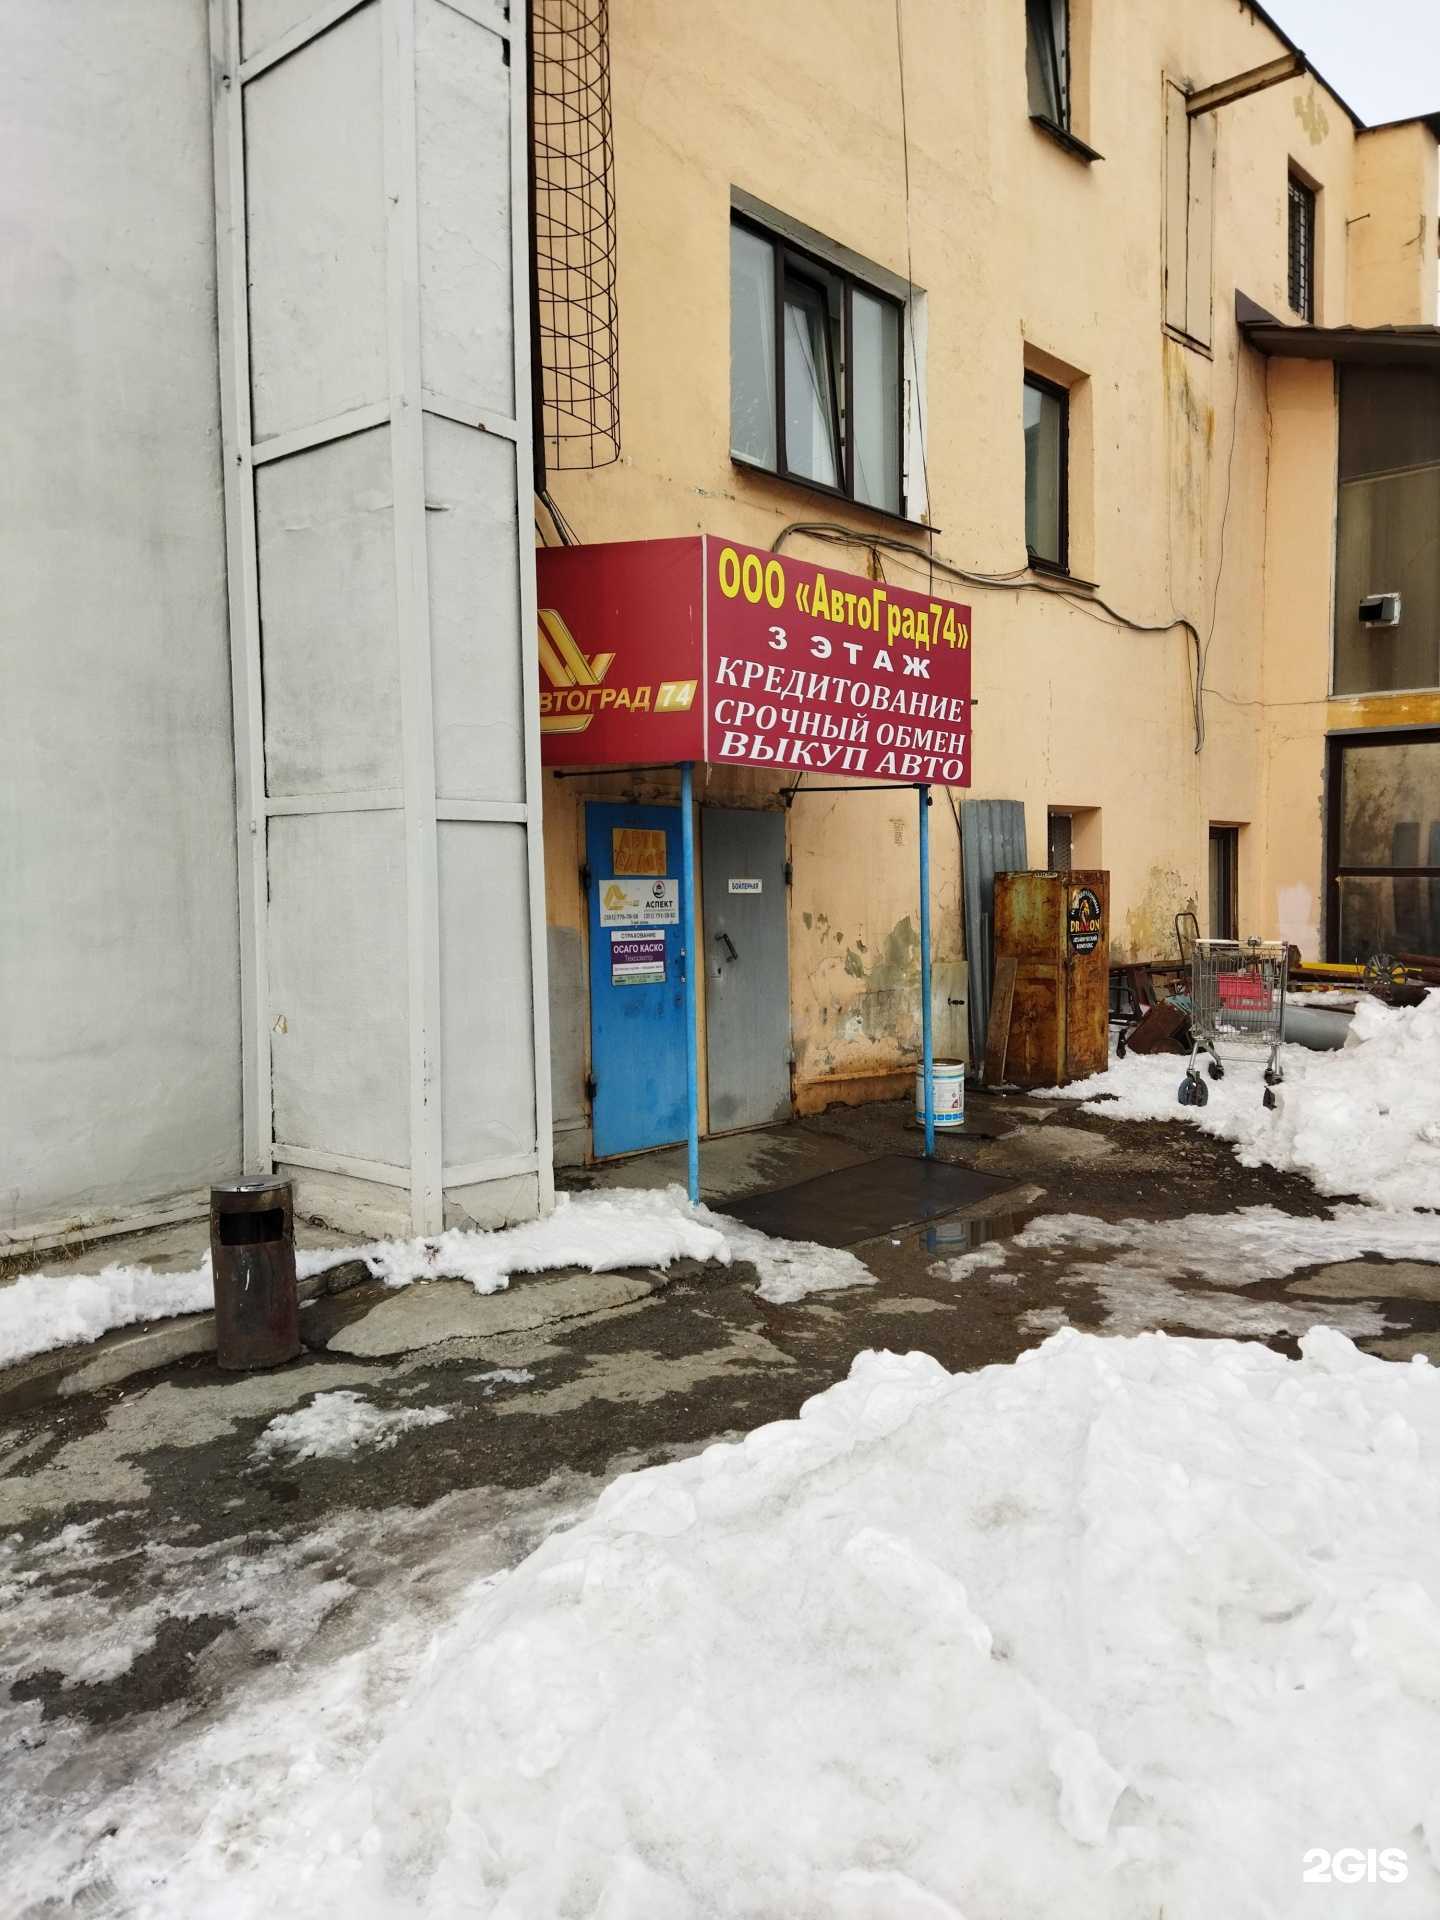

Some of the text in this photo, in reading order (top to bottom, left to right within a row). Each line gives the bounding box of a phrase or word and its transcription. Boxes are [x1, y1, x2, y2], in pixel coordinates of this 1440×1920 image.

[719, 548, 969, 651] ООО «АвтоГрад74»
[768, 626, 931, 679] 3 ЭТАЖ
[539, 684, 691, 713] ВТОГРАД 74
[715, 656, 964, 723] КРЕДИТОВАНИЕ
[714, 699, 966, 755] СРОЧНЫЙ ОБМЕН
[719, 731, 964, 780] ВЫКУП АВТО
[645, 900, 673, 908] АСПЕКТ
[613, 943, 664, 954] ОСАГО КАСКО
